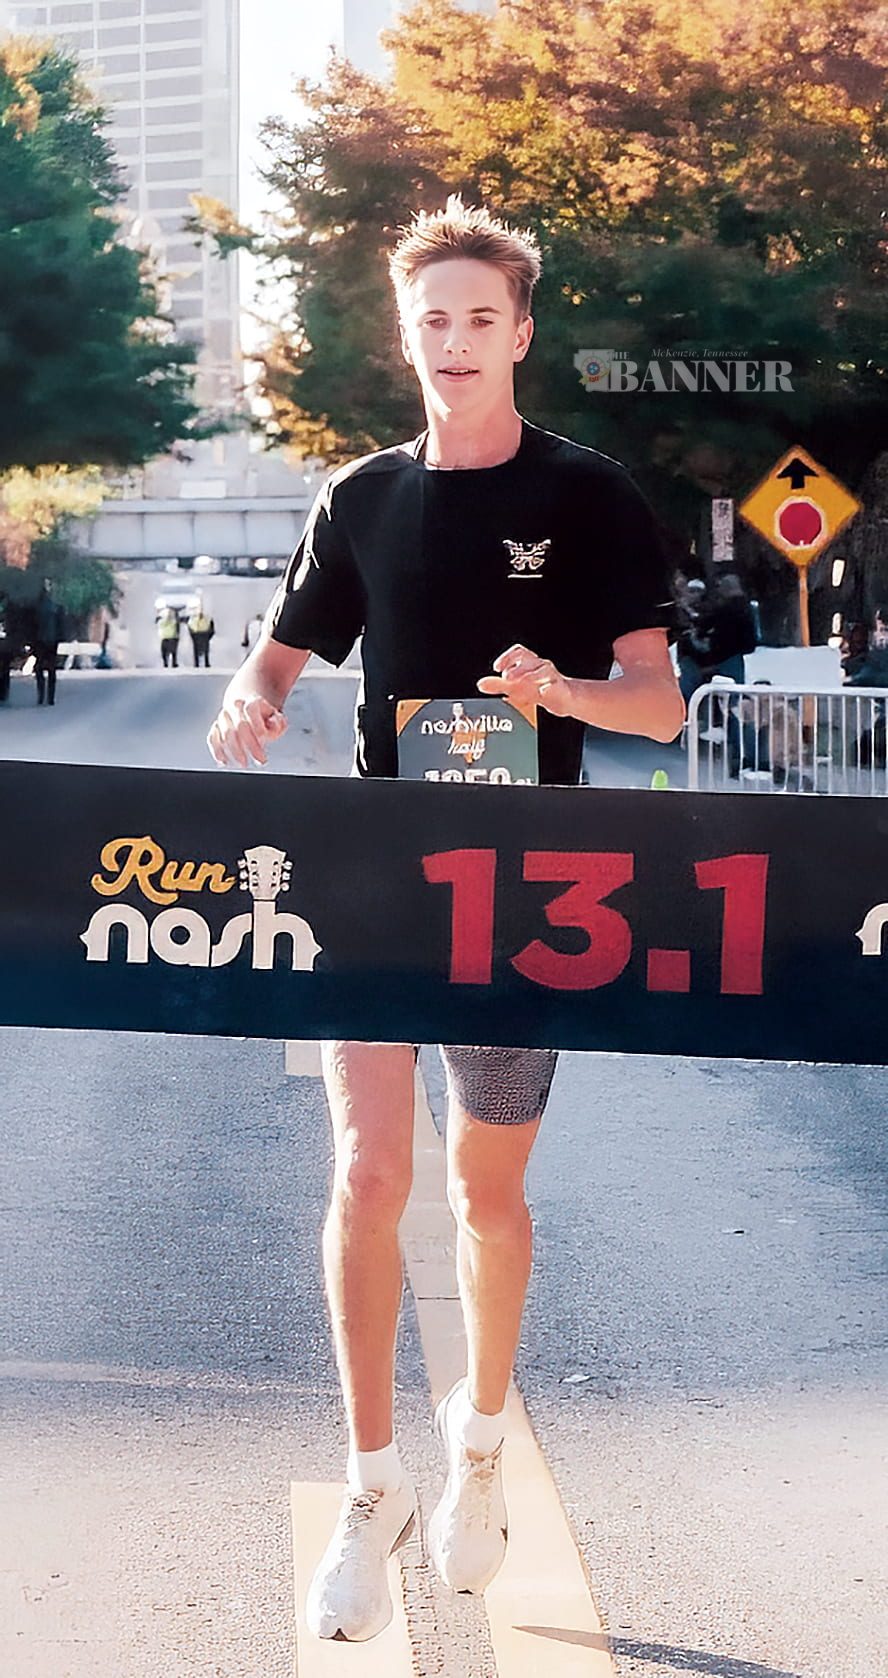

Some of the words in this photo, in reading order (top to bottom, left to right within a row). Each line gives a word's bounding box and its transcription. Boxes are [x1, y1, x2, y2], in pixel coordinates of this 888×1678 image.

[91, 835, 237, 905] Run
[79, 898, 323, 971] nash
[422, 848, 769, 995] 13.1
